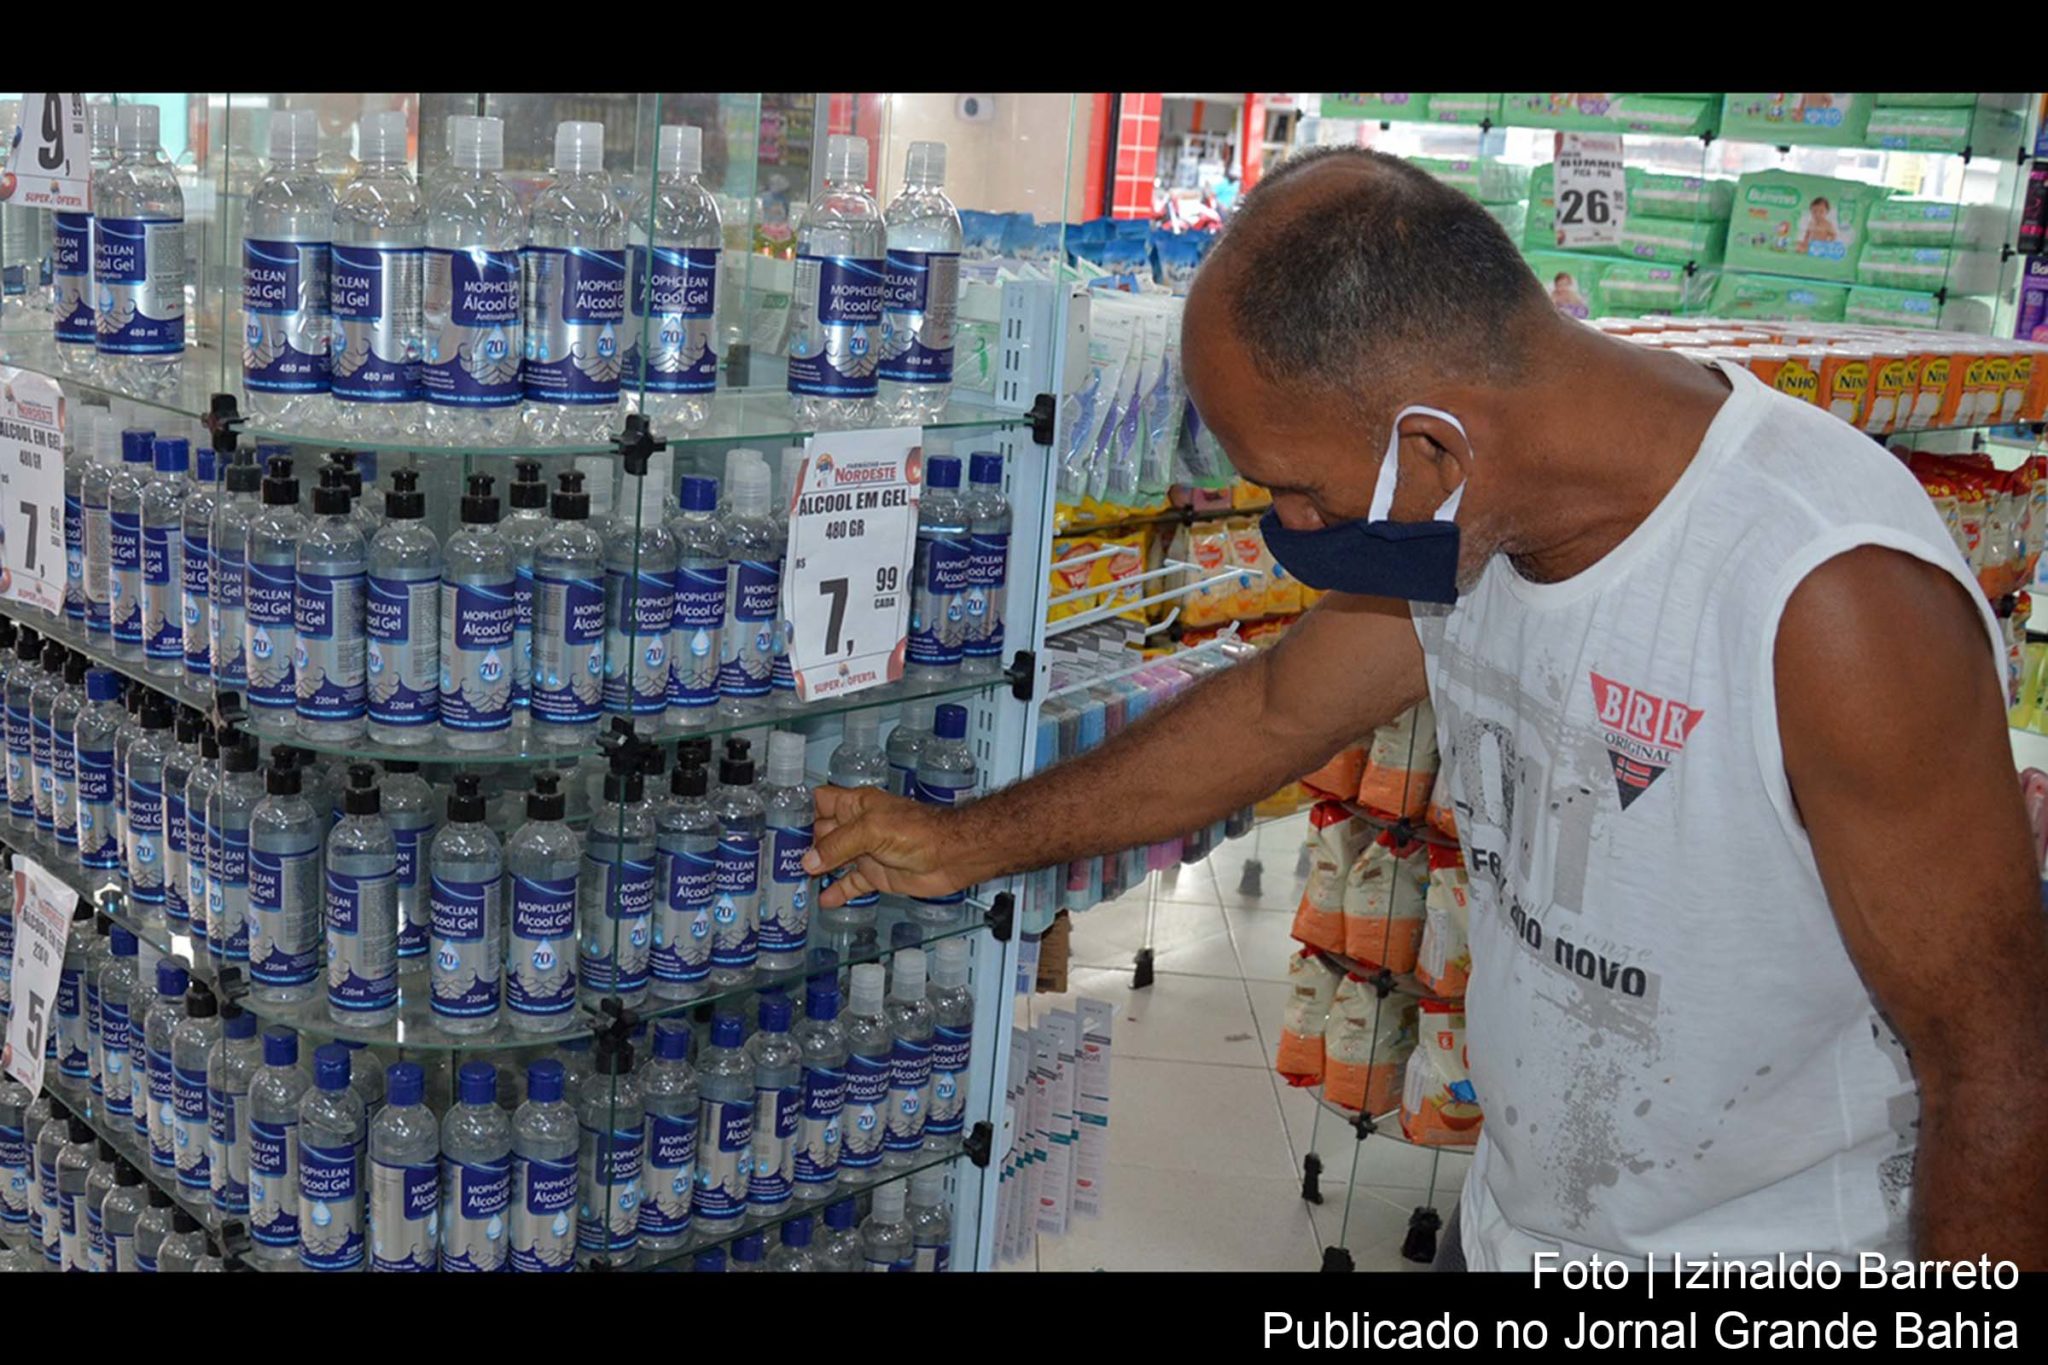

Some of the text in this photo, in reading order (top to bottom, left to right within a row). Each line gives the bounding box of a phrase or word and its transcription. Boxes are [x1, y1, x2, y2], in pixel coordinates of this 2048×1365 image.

[113, 258, 135, 271] Gel
[262, 286, 287, 300] Gel
[687, 291, 709, 304] Gel
[895, 289, 917, 301] Gel
[346, 293, 370, 308] Gel
[463, 294, 506, 312] Álcool
[576, 292, 614, 309] Álcool
[830, 297, 871, 312] Álcool
[130, 328, 159, 337] 480 ml
[279, 365, 312, 374] 480 ml
[363, 373, 395, 382] 480 ml
[34, 428, 46, 447] EM
[835, 466, 897, 483] NORDESTE
[856, 490, 879, 510] EM
[882, 489, 908, 508] GEL
[825, 519, 865, 540] 480 GR
[120, 550, 136, 559] Gel
[876, 566, 898, 592] 99
[988, 566, 1004, 578] Gel
[223, 586, 242, 597] Gel
[271, 603, 292, 615] Gel
[674, 603, 710, 616] Álcool
[874, 597, 896, 610] CADA
[306, 612, 326, 625] Gel
[382, 618, 401, 631] Gel
[463, 621, 500, 636] Álcool
[814, 670, 877, 694] SUPER OFERTA
[1600, 683, 1689, 742] BRK
[1604, 732, 1673, 762] ORIGINAL
[90, 783, 108, 794] Gel
[225, 863, 245, 874] Gel
[737, 871, 755, 883] Gel
[258, 884, 276, 899] Gel
[518, 901, 572, 913] MOPHCLEAN
[334, 908, 352, 922] Gel
[555, 912, 572, 926] Gel
[458, 918, 478, 930] Gel
[1555, 936, 1647, 988] novo
[186, 1100, 203, 1112] Gel
[262, 1152, 280, 1166] Gel
[331, 1177, 350, 1191] Gel
[533, 1188, 568, 1203] Álcool
